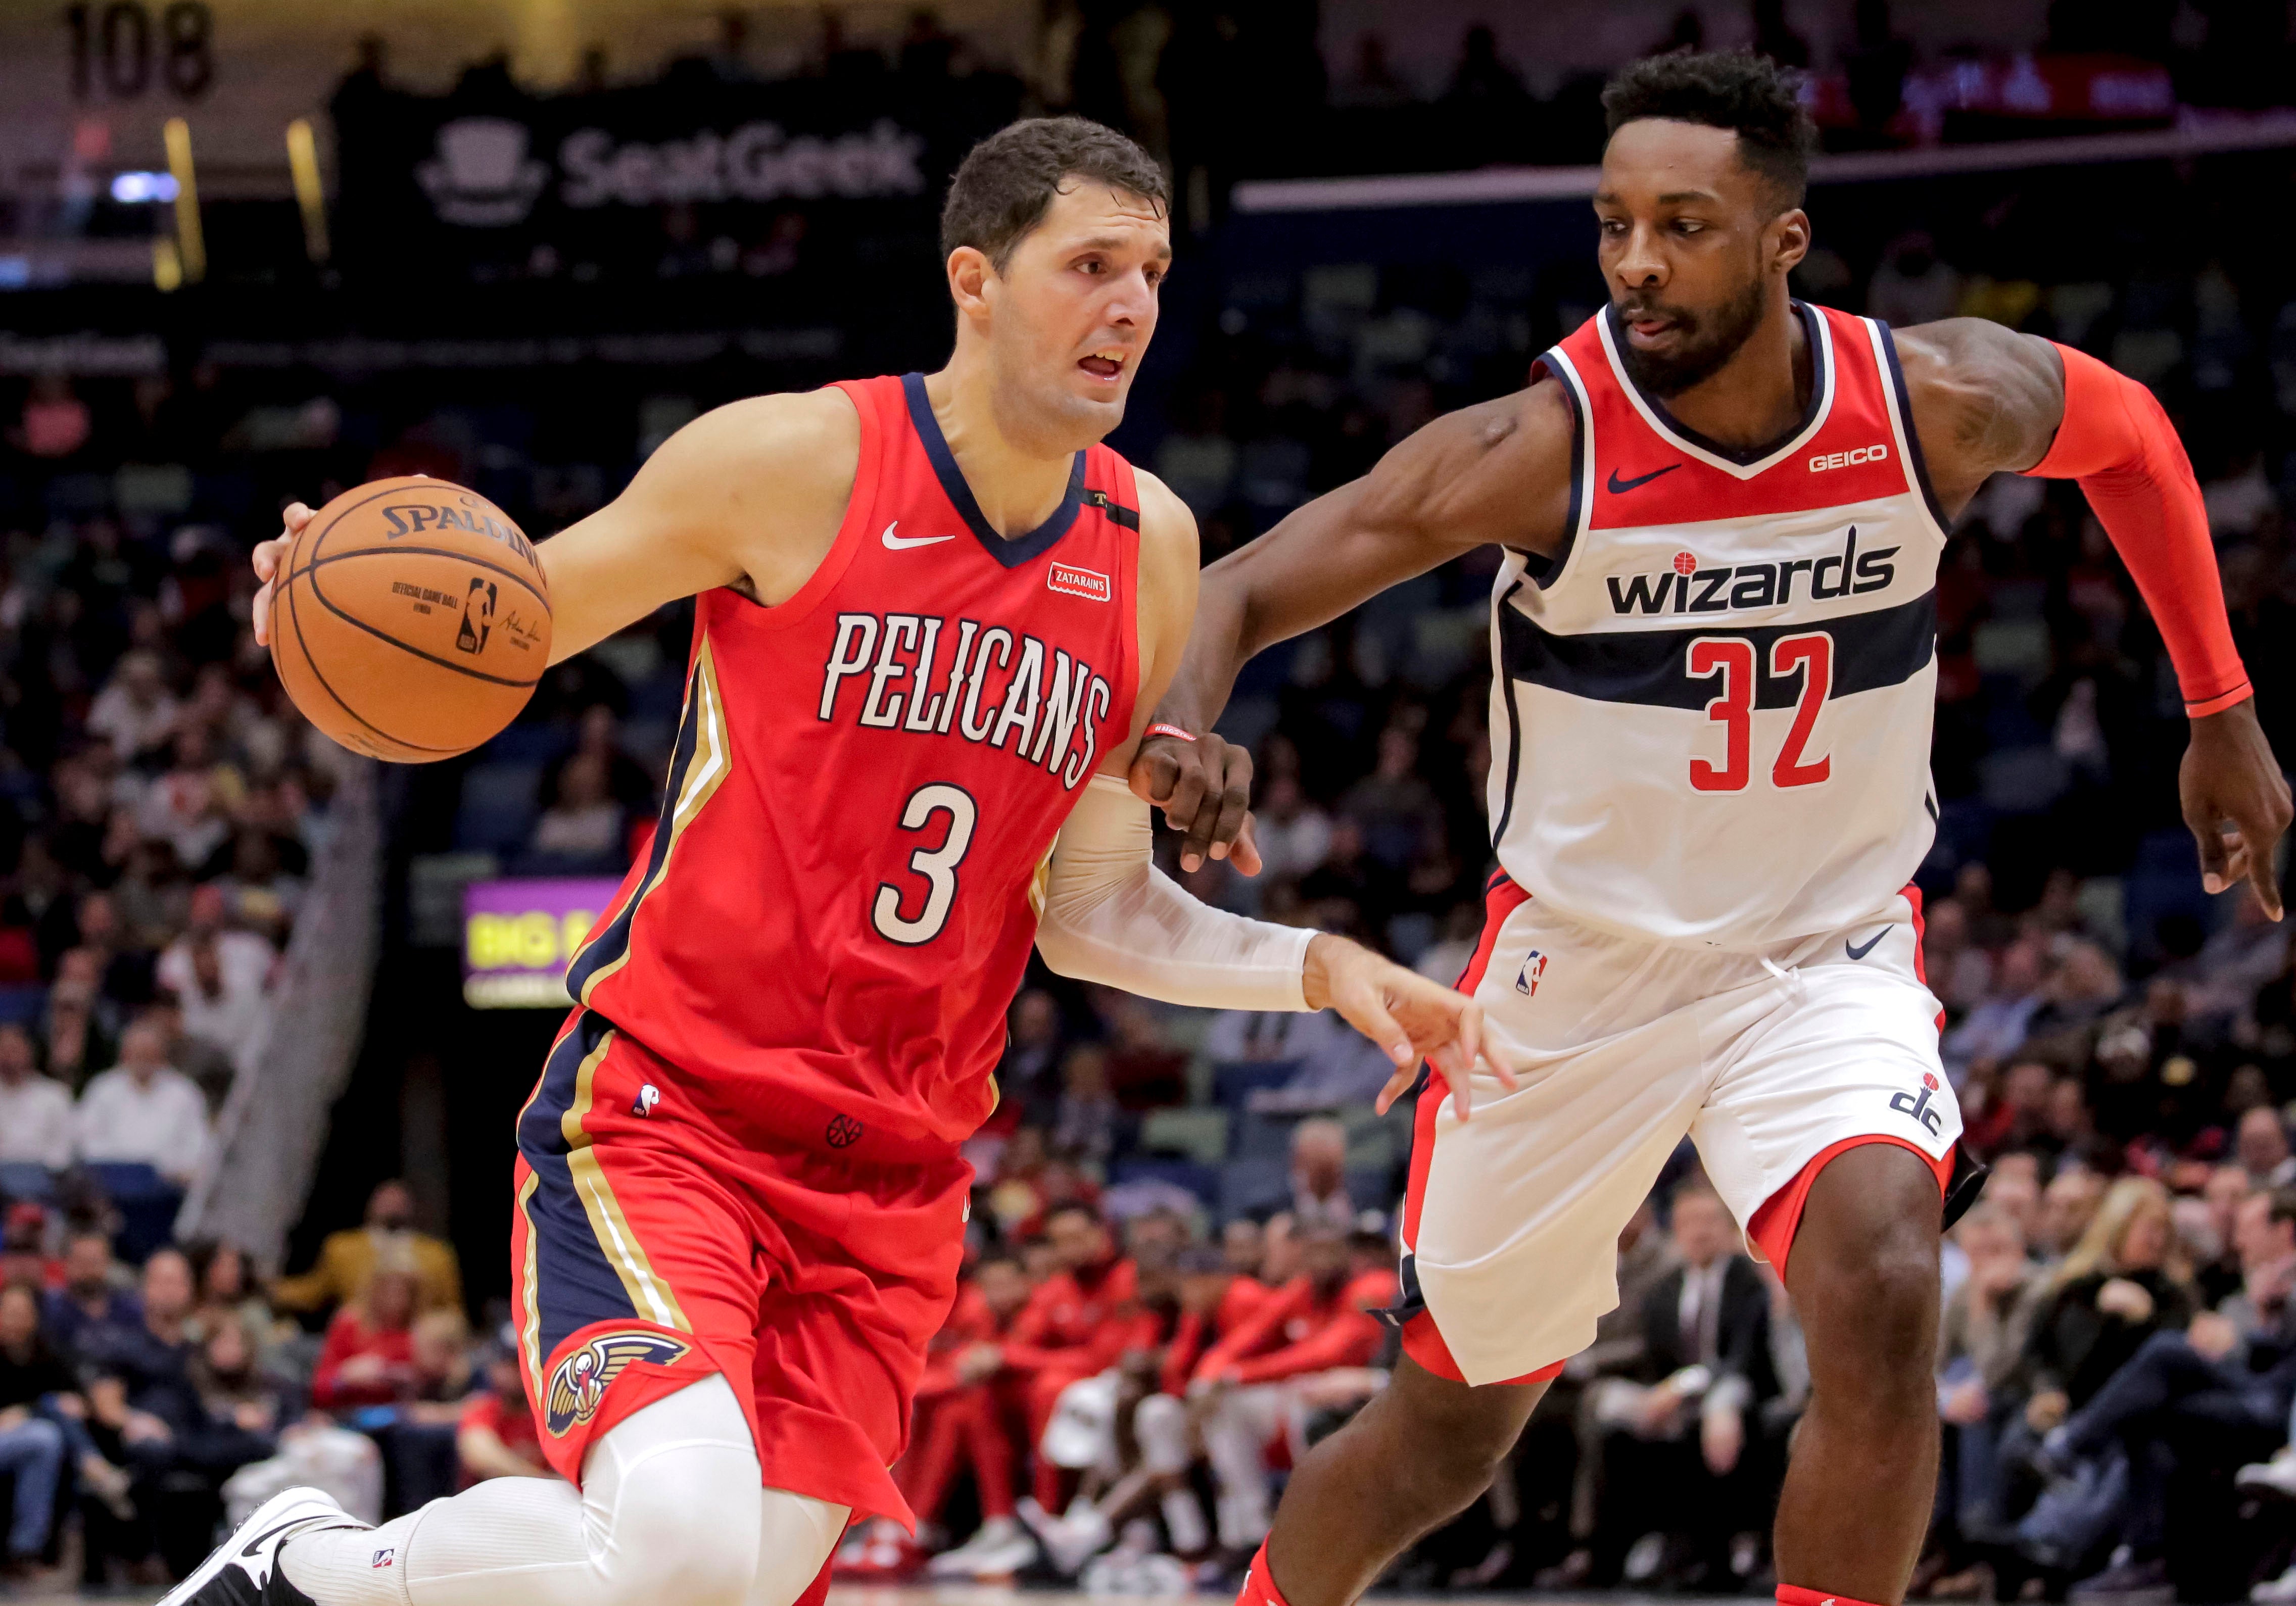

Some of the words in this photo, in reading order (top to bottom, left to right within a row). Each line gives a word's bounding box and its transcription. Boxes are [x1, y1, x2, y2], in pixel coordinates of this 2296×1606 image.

[66, 2, 212, 102] 108
[559, 120, 923, 205] SeatGeek
[1809, 444, 1888, 473] GEICO
[392, 582, 421, 599] OFFICIAL
[422, 588, 441, 604] GAME
[442, 594, 458, 609] BALL
[1056, 570, 1105, 592] ZATARAIN'S
[1607, 524, 1902, 614] wizards
[817, 612, 1111, 791] PELICANS
[1687, 630, 1833, 796] 32
[873, 781, 978, 946] 3
[467, 910, 554, 971] BIG
[1517, 984, 1528, 994] NBA
